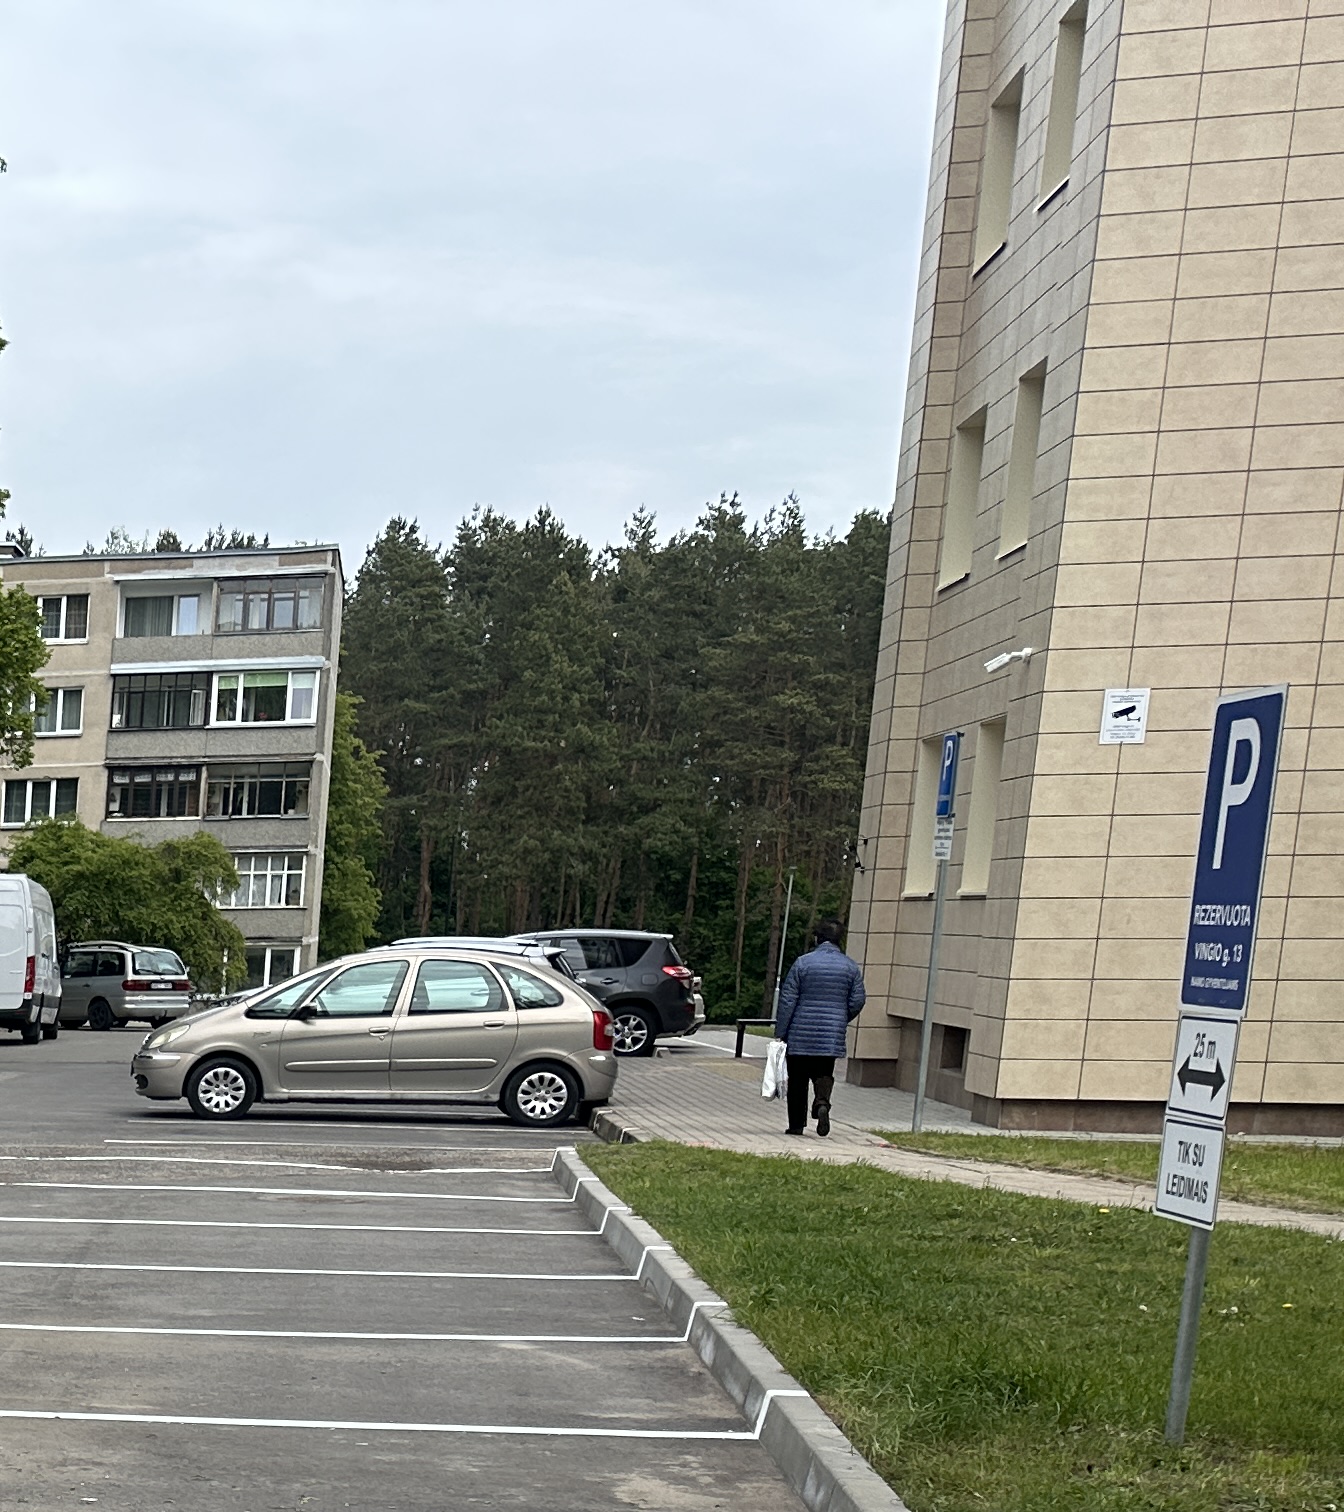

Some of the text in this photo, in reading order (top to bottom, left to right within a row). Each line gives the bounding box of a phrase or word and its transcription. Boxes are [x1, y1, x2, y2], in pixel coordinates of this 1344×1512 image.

[943, 740, 954, 781] P
[1212, 717, 1261, 870] P
[1193, 904, 1251, 926] REZERVUOTA
[1194, 943, 1243, 967] VINGIO g. 13
[1193, 1033, 1217, 1060] 25 m
[1177, 1141, 1207, 1167] TIK SU
[1166, 1172, 1209, 1204] LEIDIMAIS
